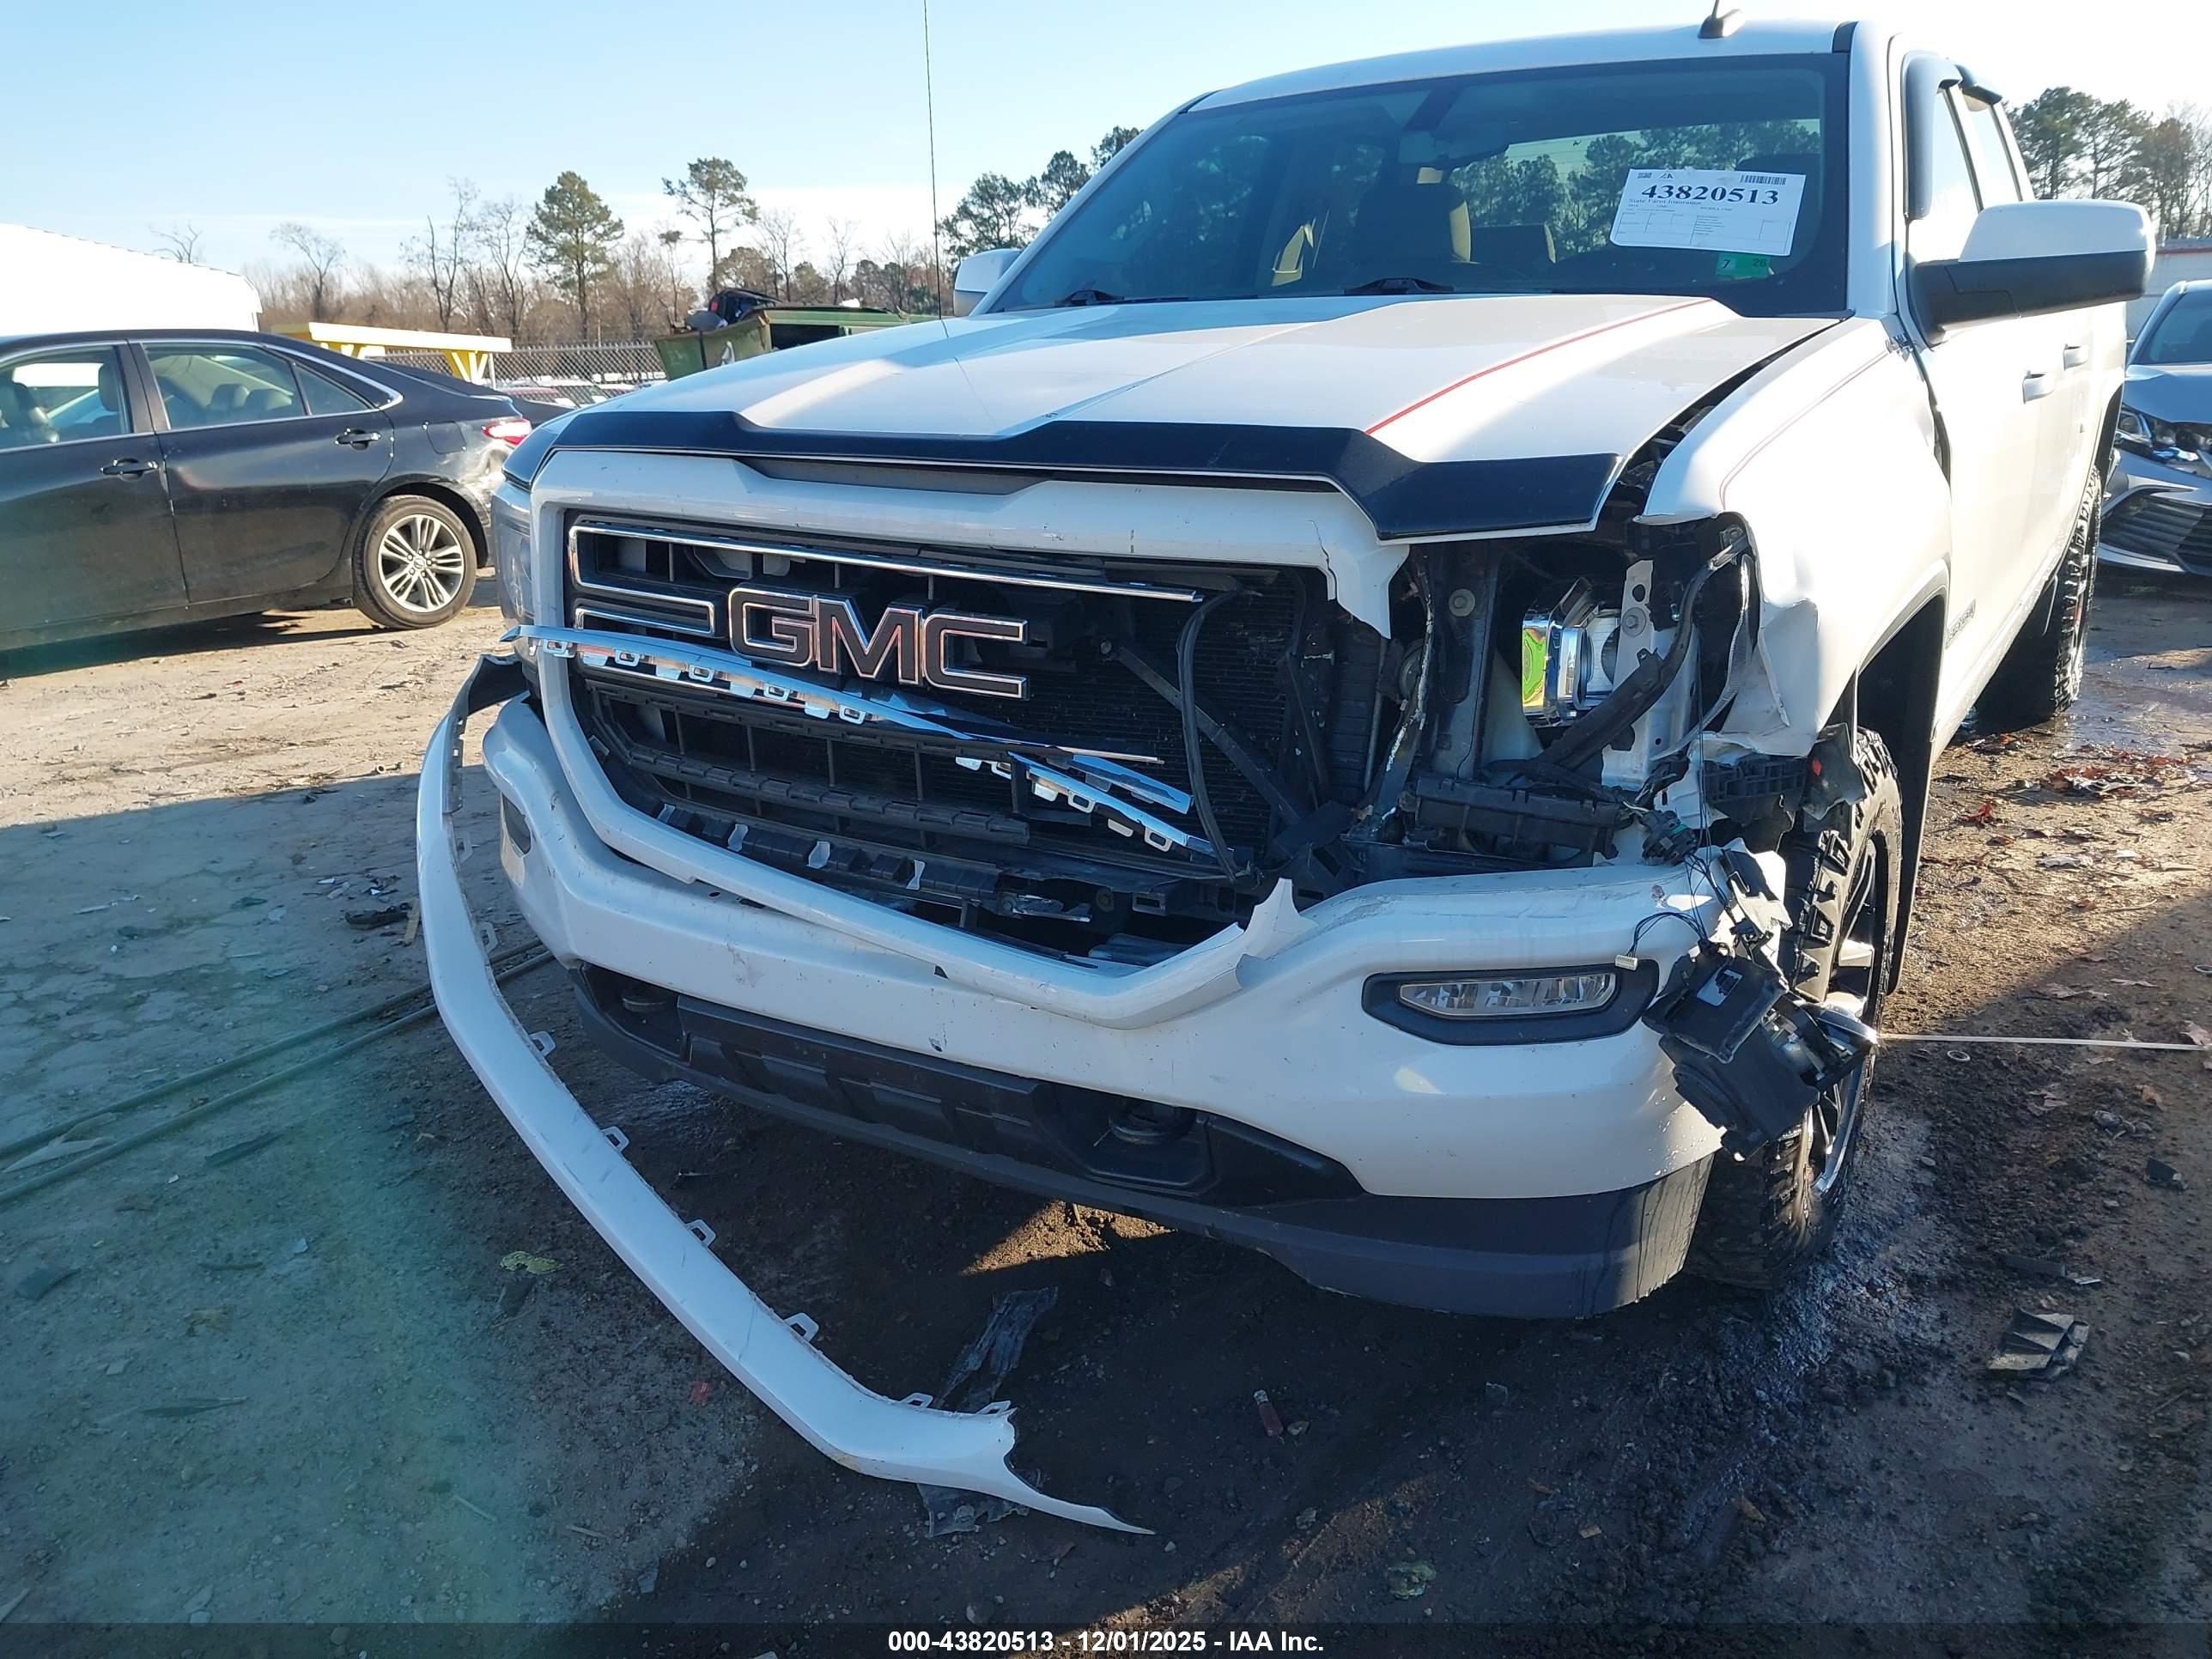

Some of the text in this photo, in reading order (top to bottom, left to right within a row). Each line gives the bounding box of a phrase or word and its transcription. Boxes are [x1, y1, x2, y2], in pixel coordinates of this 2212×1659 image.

[1641, 184, 1779, 205] 43820513
[1722, 258, 1731, 269] 7
[728, 586, 1027, 700] GMC
